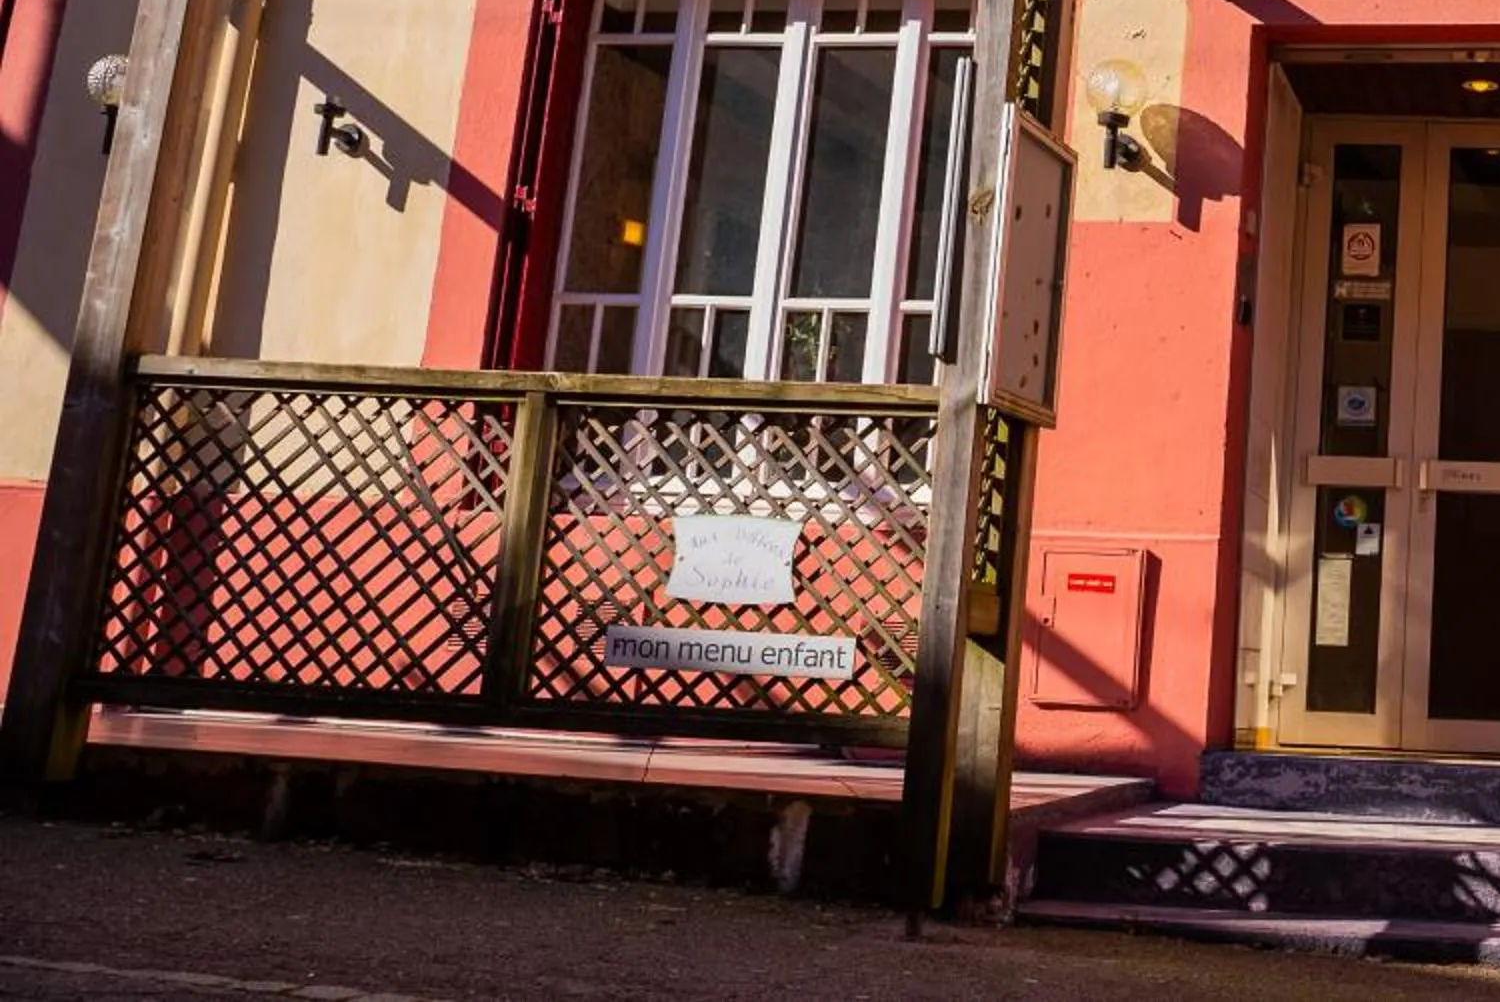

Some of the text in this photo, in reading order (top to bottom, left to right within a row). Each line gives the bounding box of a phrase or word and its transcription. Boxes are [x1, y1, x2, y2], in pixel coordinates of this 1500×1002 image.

[612, 637, 847, 669] mon menu enfant
